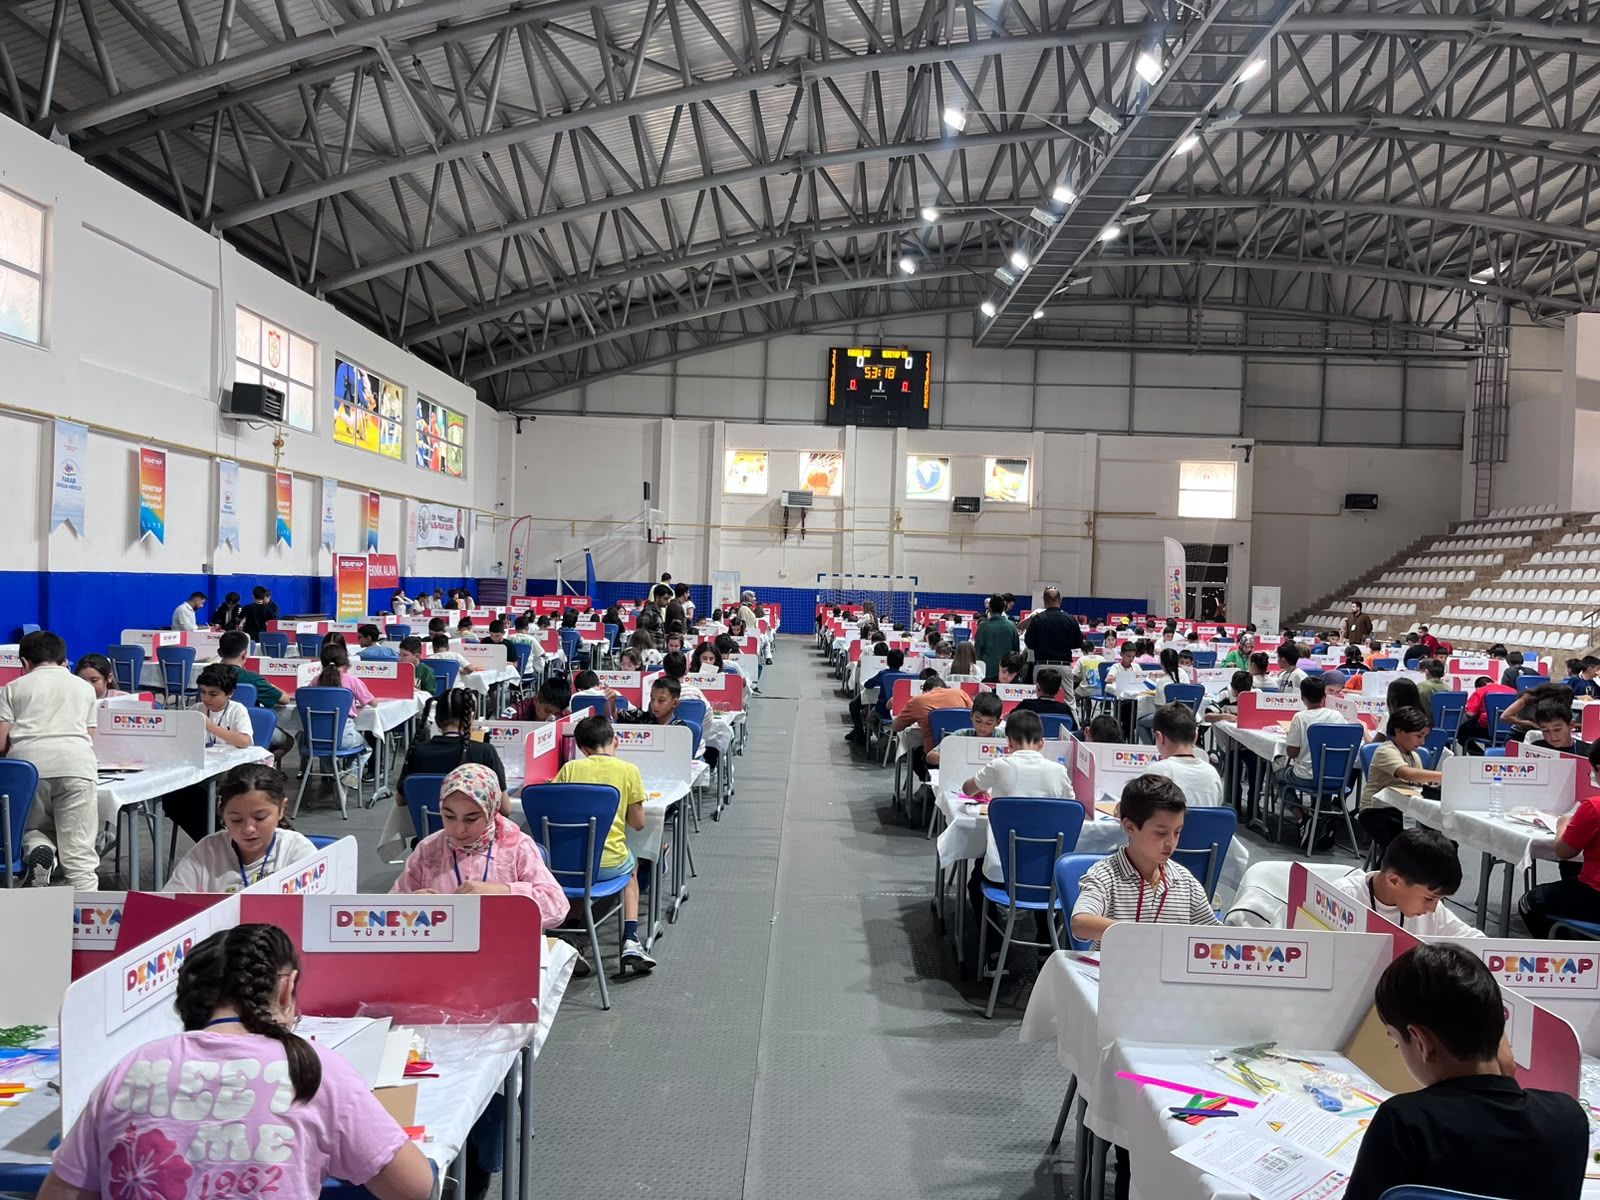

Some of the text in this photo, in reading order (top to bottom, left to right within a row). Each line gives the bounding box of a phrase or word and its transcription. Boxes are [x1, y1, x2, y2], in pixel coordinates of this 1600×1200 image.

[856, 356, 864, 367] 0
[905, 357, 913, 369] 0
[114, 715, 162, 725] DENEYAP
[1485, 764, 1535, 773] DENEYAP
[1316, 890, 1354, 926] DENEYAP
[336, 910, 448, 928] DENEYAP
[354, 928, 431, 937] TÜRKİYE
[1193, 942, 1302, 963] DENEYAP
[126, 937, 193, 992] DENEYAP
[1209, 961, 1286, 973] TÜRKİYE
[1488, 955, 1594, 975] DENEYAP
[137, 967, 179, 996] TÜRKİY
[1504, 973, 1577, 984] TÜRKİYE
[186, 1123, 296, 1163] ME
[199, 1164, 284, 1200] 1962
